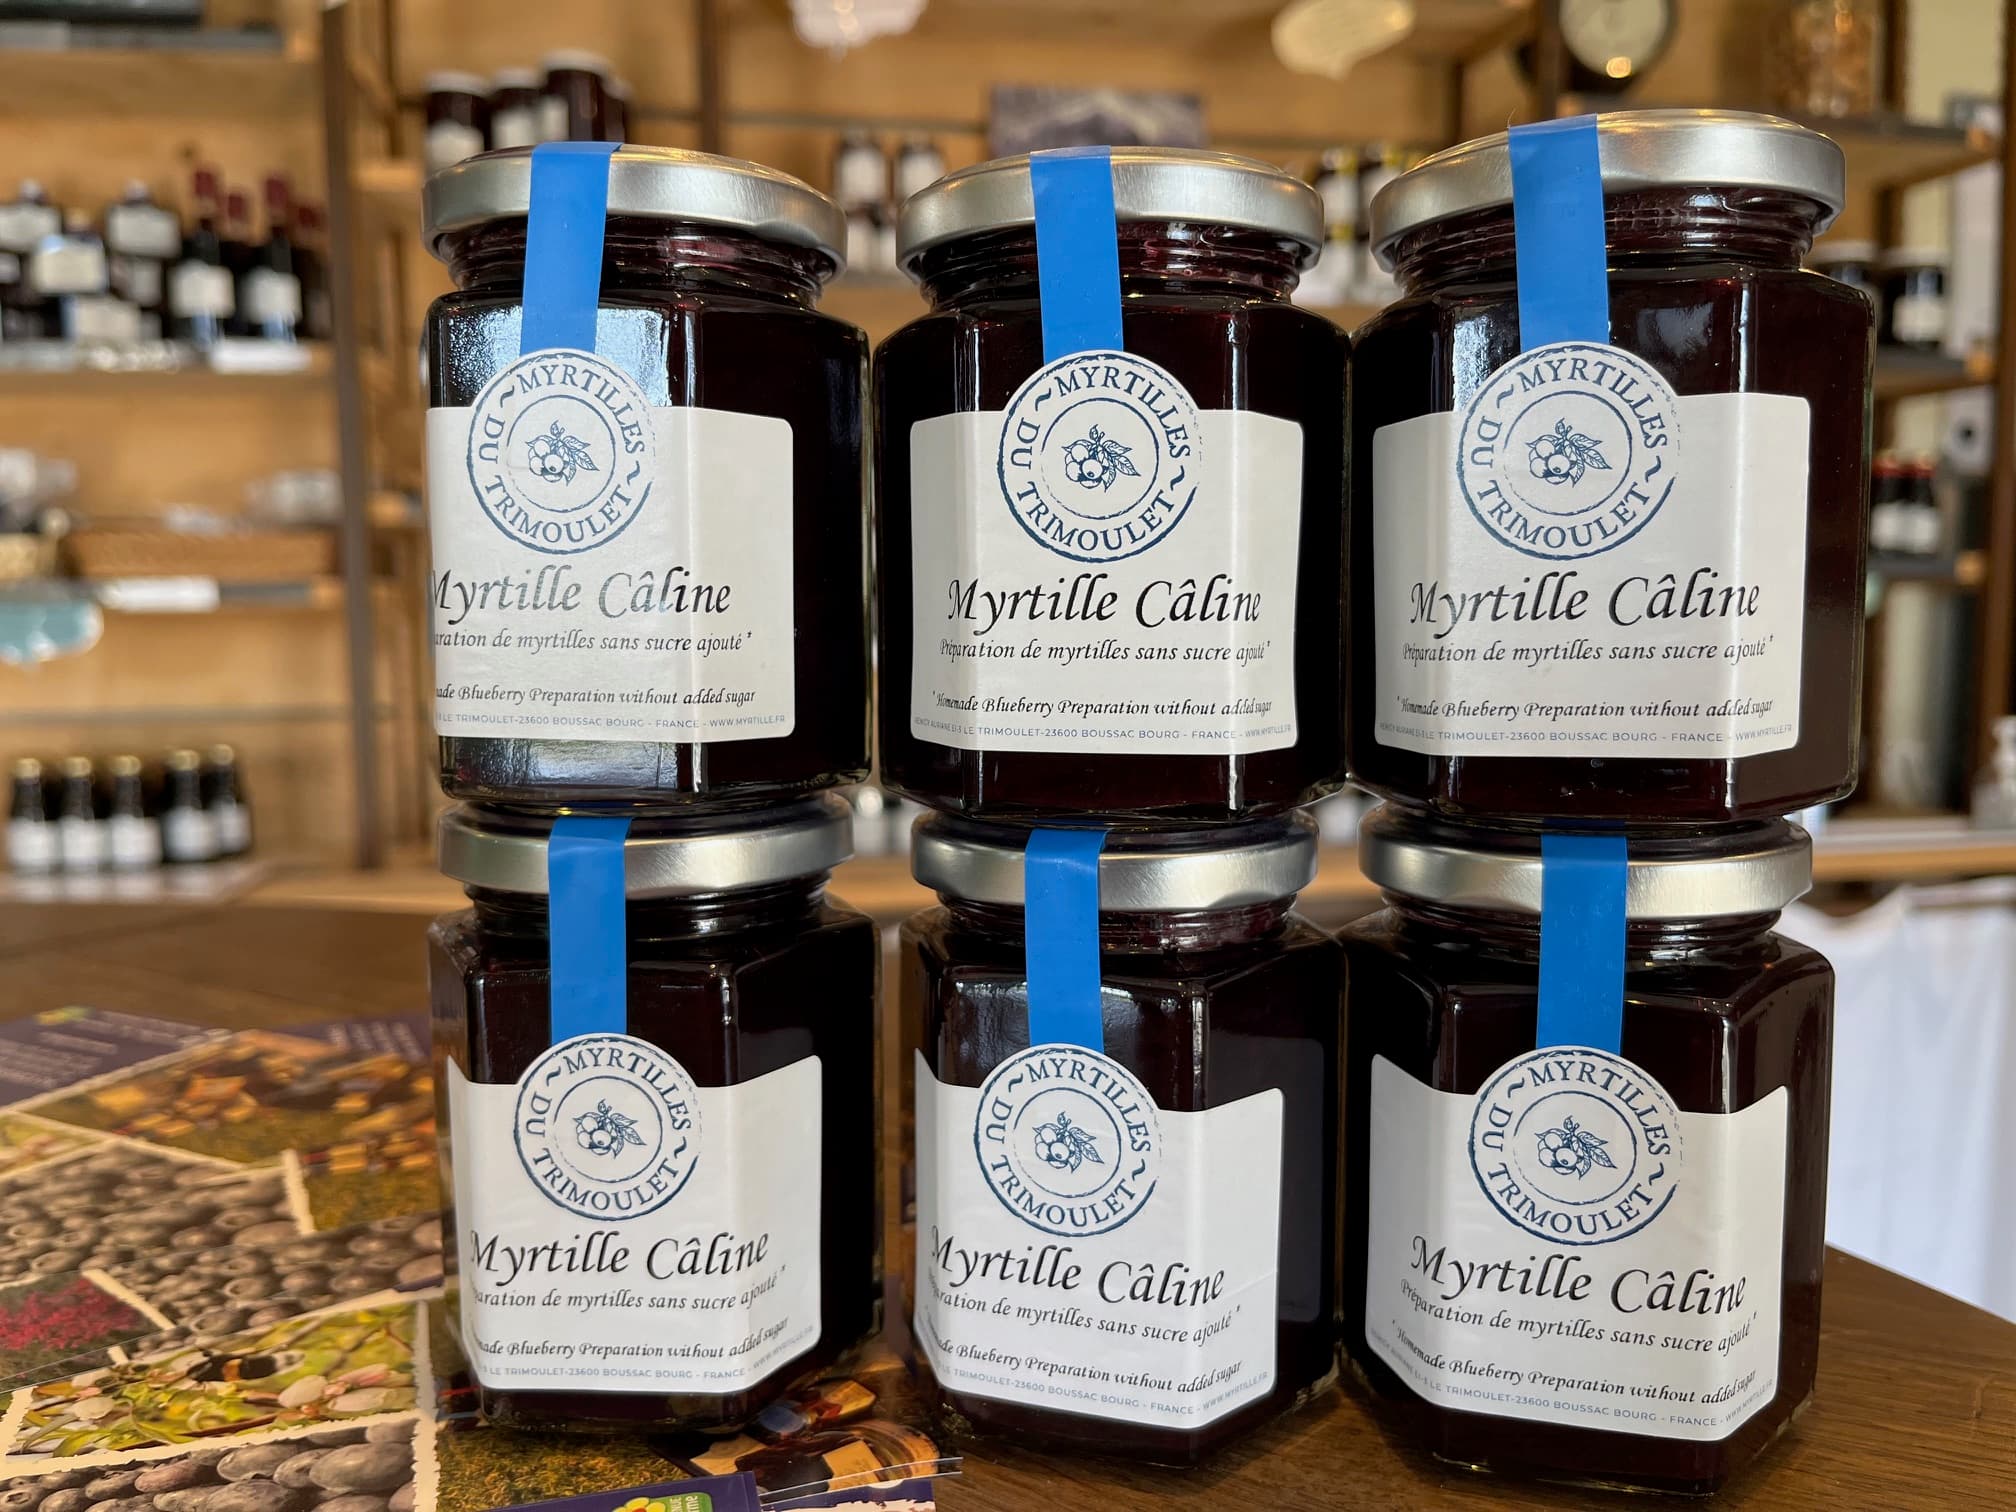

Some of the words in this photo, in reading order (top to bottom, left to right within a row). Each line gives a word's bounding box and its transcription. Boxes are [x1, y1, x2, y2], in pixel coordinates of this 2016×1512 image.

[516, 364, 645, 454] MYRTILLES
[1054, 365, 1191, 459] MYRTILLES
[1517, 357, 1668, 449] MYRTILLES
[479, 414, 505, 464] DU
[1010, 417, 1040, 470] DU
[1471, 415, 1503, 469] DU
[485, 475, 632, 543] TRIMOULET
[1017, 481, 1175, 550] TRIMOULET
[1477, 479, 1650, 548] TRIMOULET
[432, 564, 582, 625] Myrtille
[599, 566, 731, 618] Câline
[948, 573, 1118, 636] Myrtille
[1135, 573, 1261, 628] Câline
[1410, 571, 1589, 639] Myrtille
[1608, 567, 1760, 626] Câline
[492, 628, 512, 648] de
[517, 629, 595, 655] myrtilles
[600, 637, 640, 651] sans
[645, 637, 691, 651] sucre
[940, 638, 1014, 663] Préparation
[1021, 638, 1042, 659] de
[1048, 639, 1130, 666] myrtilles
[1135, 646, 1178, 660] sans
[1183, 646, 1231, 660] sucre
[1403, 643, 1476, 667] Préparation
[1483, 640, 1506, 661] de
[1512, 638, 1604, 668] myrtilles
[1609, 645, 1656, 660] sans
[1662, 645, 1717, 659] sucre
[456, 714, 550, 725] TRIMOULET-23600
[553, 716, 602, 726] BOUSSAC
[656, 719, 699, 728] FRANCE
[710, 715, 785, 728] WWW.MYRTILLE.FR
[458, 684, 525, 706] Blueberry
[529, 687, 615, 707] Preparation
[618, 688, 678, 704] without
[683, 687, 726, 705] added
[725, 691, 756, 707] sugar
[981, 696, 1054, 718] Blueberry
[1057, 699, 1149, 719] Preparation
[1154, 698, 1216, 715] without
[1221, 698, 1255, 715] added
[1255, 700, 1272, 717] sugar
[1441, 700, 1520, 722] Blueberry
[1524, 702, 1624, 722] Preparation
[1630, 700, 1700, 717] without
[1706, 698, 1750, 717] added
[1750, 699, 1774, 718] sugar
[978, 727, 1078, 737] TRIMOULET-23600
[1081, 729, 1135, 739] BOUSSAC
[1139, 729, 1180, 739] BOURG
[1192, 730, 1238, 739] FRANCE
[1439, 731, 1546, 741] TRIMOULET-23600
[1550, 732, 1607, 741] BOUSSAC
[1612, 732, 1657, 742] BOURG
[1671, 733, 1723, 742] FRANCE
[563, 1047, 691, 1131] MYRTILLES
[1025, 1058, 1151, 1152] MYRTILLES
[1528, 1060, 1671, 1156] MYRTILLES
[525, 1092, 552, 1138] DU
[986, 1096, 1013, 1144] DU
[1482, 1103, 1513, 1152] DU
[532, 1147, 679, 1211] TRIMOULET
[991, 1154, 1136, 1227] TRIMOULET
[1488, 1162, 1653, 1235] TRIMOULET
[471, 1230, 630, 1287] Myrtille
[646, 1232, 769, 1280] Câline
[932, 1225, 1081, 1290] Myrtille
[1098, 1261, 1225, 1307] Câline
[1411, 1235, 1592, 1301] Myrtille
[1611, 1269, 1746, 1315] Câline
[541, 1288, 562, 1307] de
[567, 1289, 644, 1312] myrtilles
[648, 1296, 687, 1309] sans
[691, 1296, 737, 1310] sucre
[991, 1297, 1011, 1315] de
[1016, 1308, 1094, 1329] myrtilles
[1097, 1318, 1137, 1336] sans
[1141, 1326, 1188, 1343] sucre
[1400, 1279, 1484, 1326] Préparation
[1489, 1310, 1511, 1329] de
[1517, 1319, 1605, 1341] myrtilles
[1610, 1329, 1656, 1346] sans
[1660, 1336, 1713, 1352] sucre
[506, 1340, 576, 1359] Blueberry
[579, 1342, 663, 1360] Preparation
[668, 1343, 724, 1358] without
[729, 1327, 764, 1356] added
[763, 1316, 789, 1340] sugar
[505, 1367, 600, 1377] TRIMOULET-23600
[603, 1368, 651, 1377] BOUSSAC
[703, 1368, 745, 1379] FRANCE
[954, 1367, 1045, 1393] TRIMOULET-23600
[1048, 1386, 1098, 1401] BOUSSAC
[1100, 1394, 1140, 1407] BOURG
[1150, 1402, 1194, 1415] FRANCE
[956, 1344, 1022, 1371] Blueberry
[1025, 1356, 1110, 1381] Preparation
[1114, 1372, 1173, 1391] without
[1177, 1368, 1216, 1393] added
[1215, 1360, 1243, 1383] sugar
[1449, 1359, 1524, 1386] Blueberry
[1527, 1370, 1625, 1395] Preparation
[1630, 1384, 1695, 1403] without
[1701, 1379, 1738, 1404] added
[1736, 1370, 1756, 1392] sugar
[1446, 1385, 1550, 1407] TRIMOULET-23600
[1553, 1400, 1609, 1416] BOUSSAC
[1613, 1408, 1657, 1421] BOURG
[1669, 1415, 1717, 1426] FRANCE
